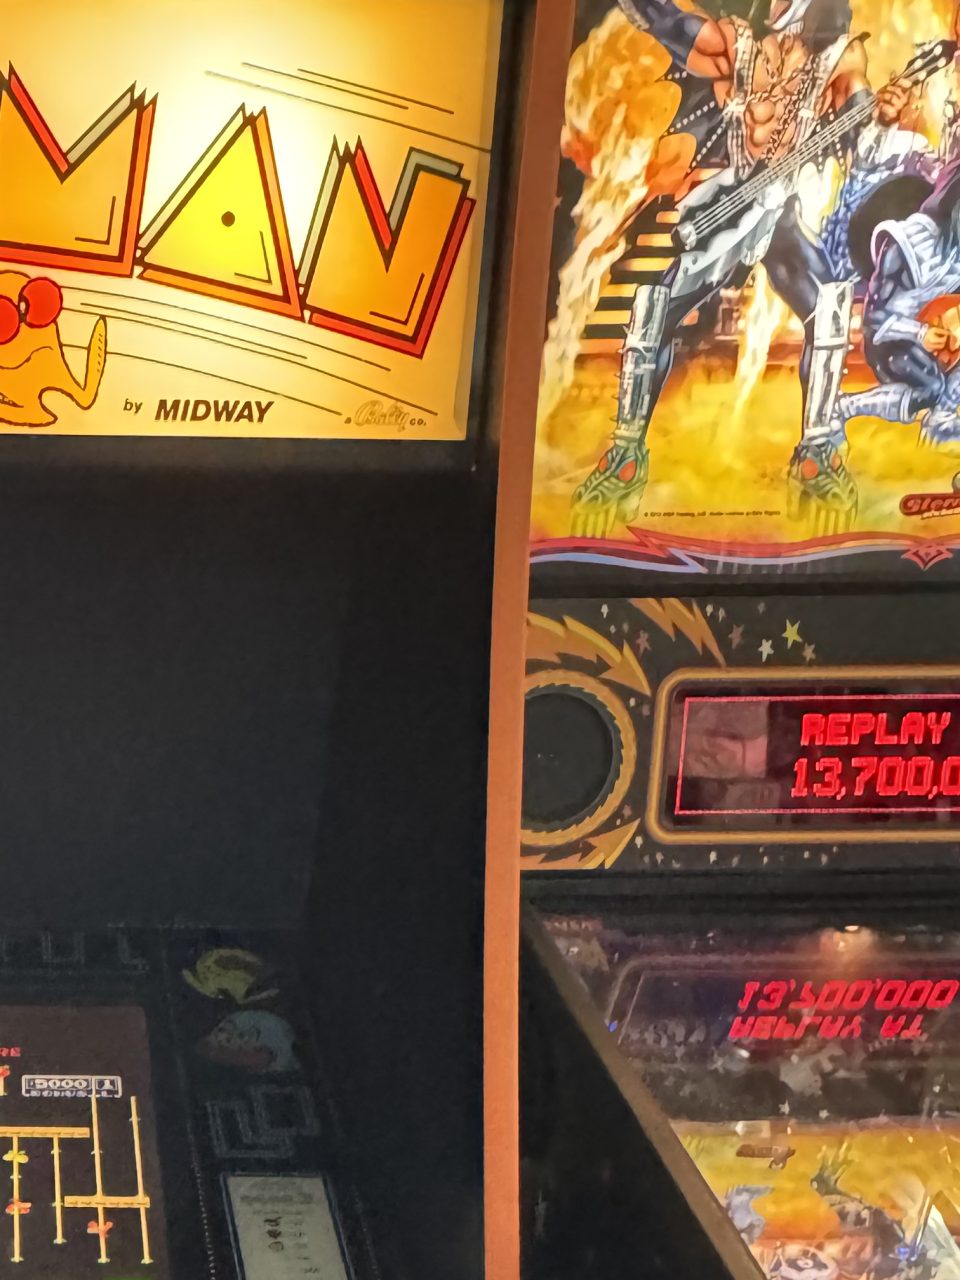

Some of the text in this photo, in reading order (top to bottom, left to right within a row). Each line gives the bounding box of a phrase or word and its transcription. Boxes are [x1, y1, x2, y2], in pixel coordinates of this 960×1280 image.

[123, 398, 275, 423] by MIDWAY
[800, 711, 952, 746] REPLAY
[791, 755, 960, 800] 13,700,0
